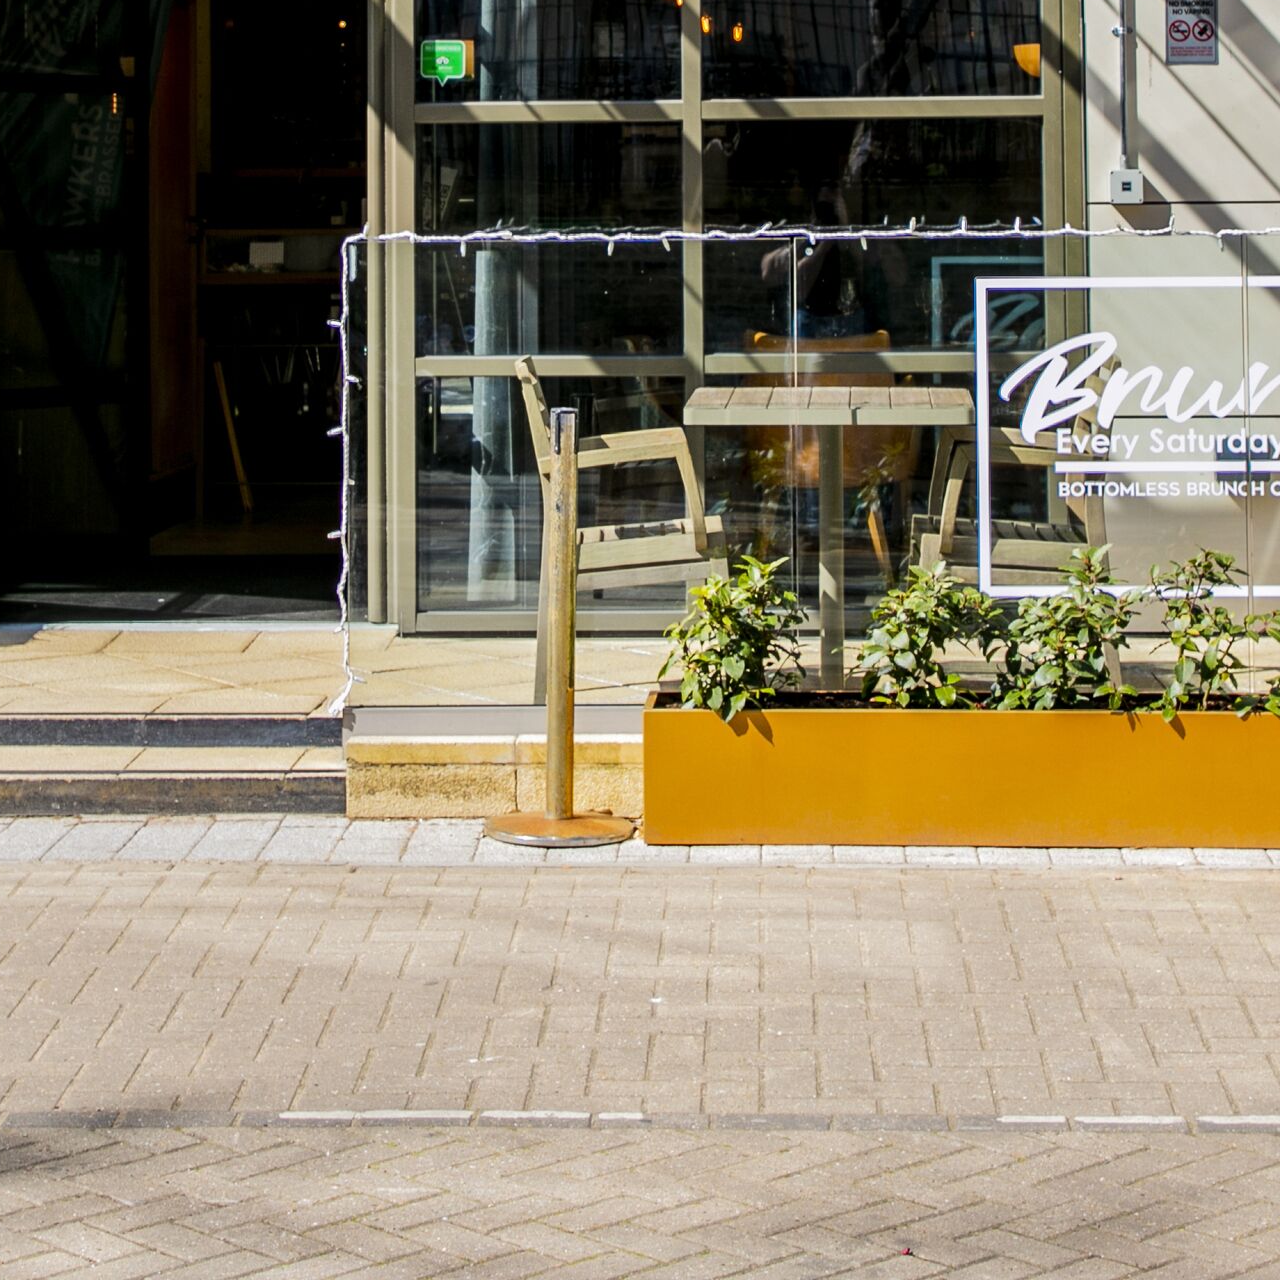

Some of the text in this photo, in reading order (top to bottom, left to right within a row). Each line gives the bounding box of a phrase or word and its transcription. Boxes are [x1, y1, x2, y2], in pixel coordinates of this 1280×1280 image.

[1056, 428, 1140, 460] Every
[1058, 481, 1180, 498] BOTTOMLESS
[1186, 480, 1265, 498] BRUNCH
